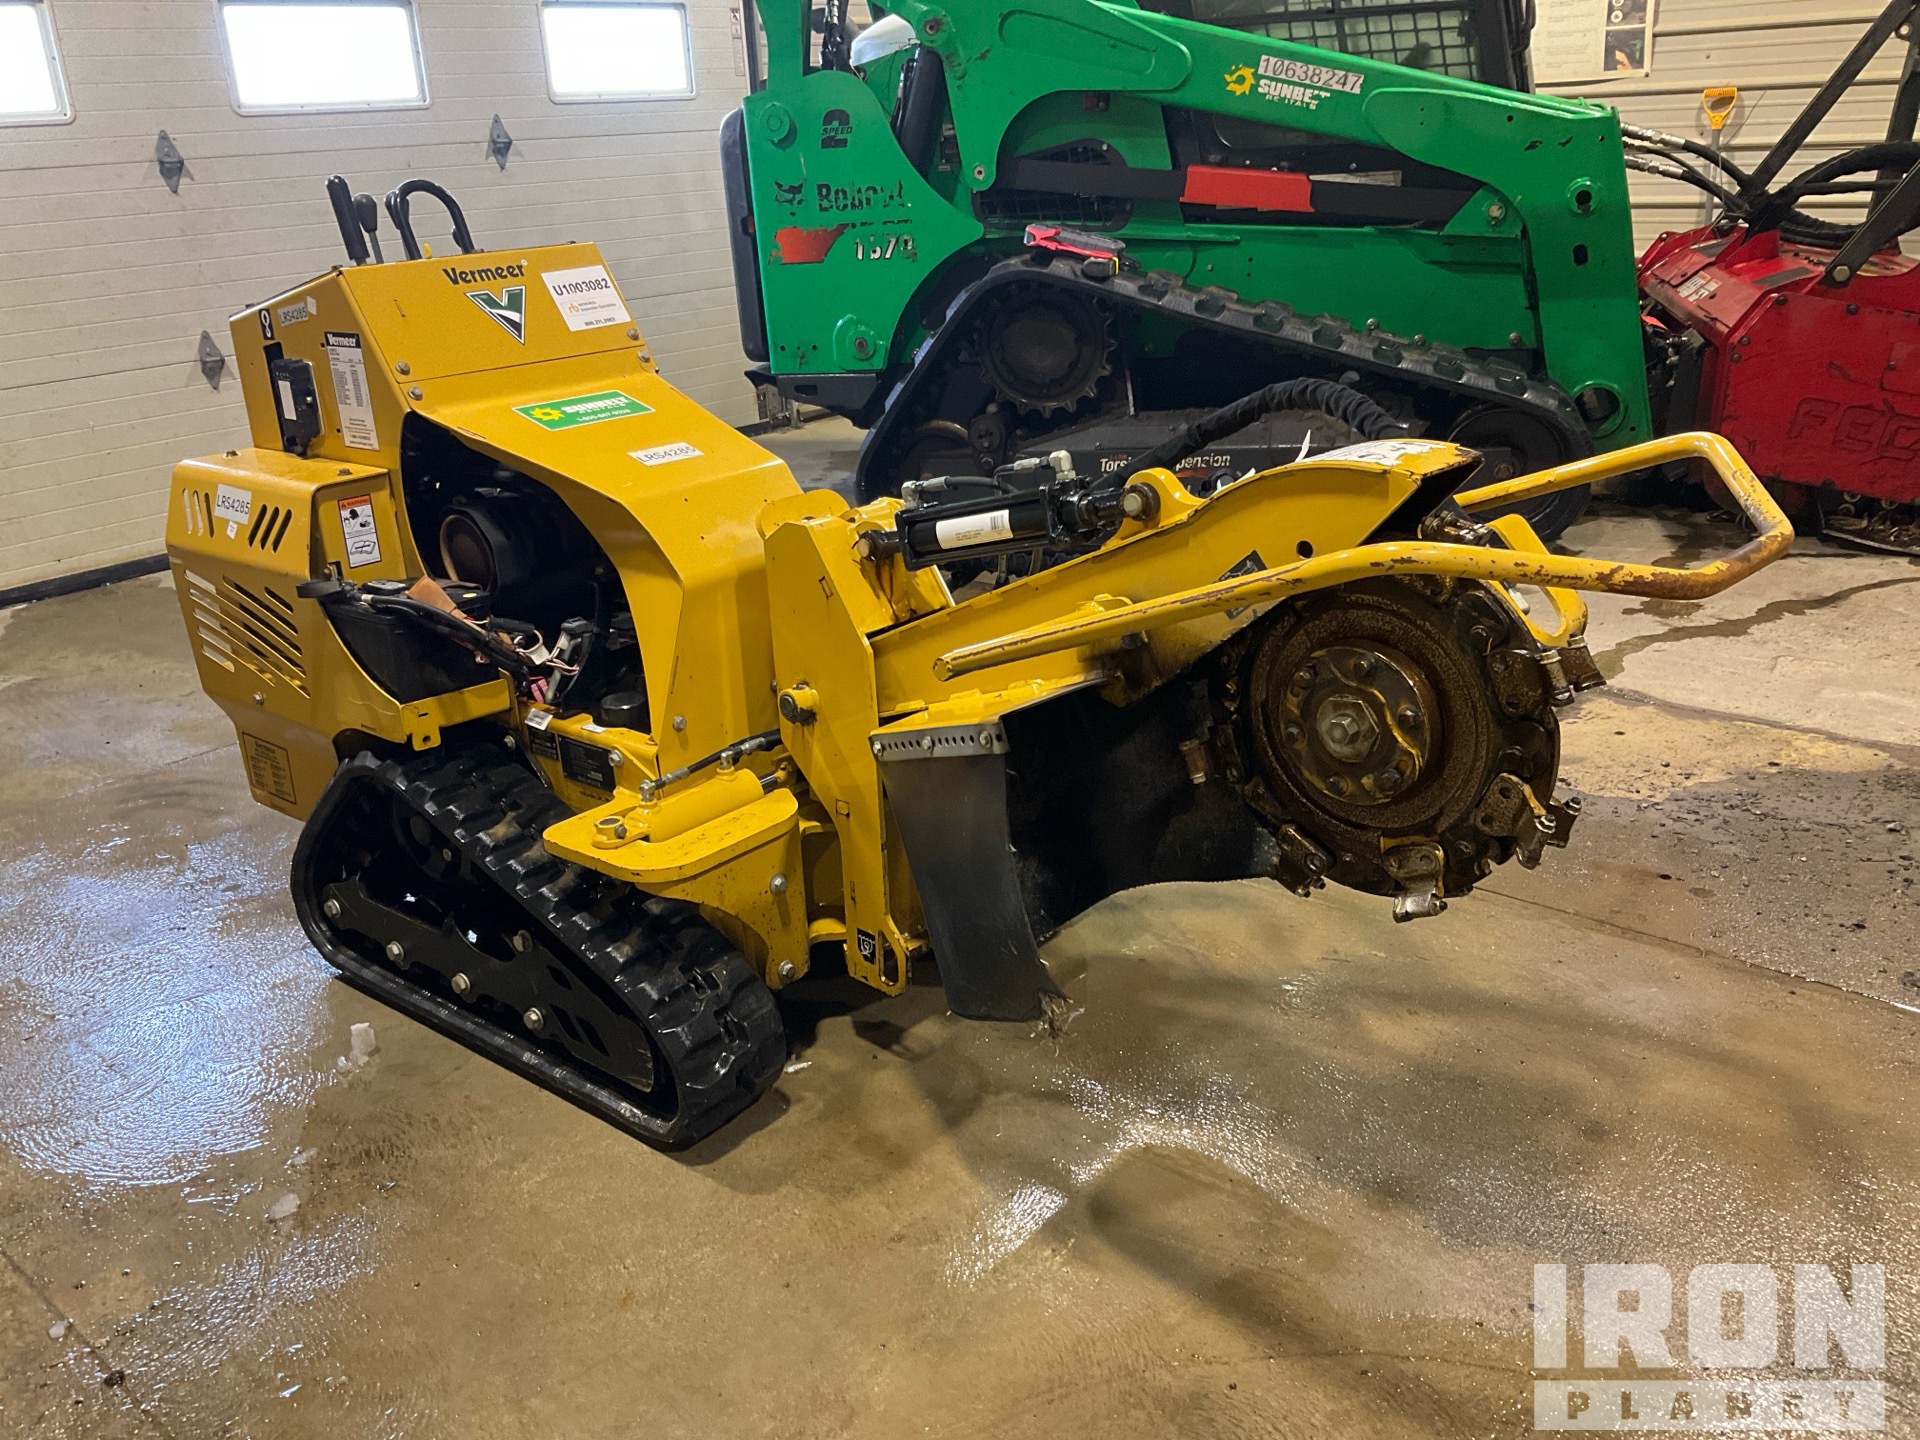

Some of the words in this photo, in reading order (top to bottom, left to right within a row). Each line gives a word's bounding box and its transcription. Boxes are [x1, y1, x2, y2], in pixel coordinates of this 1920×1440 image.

[1262, 56, 1364, 92] 10638247
[821, 126, 853, 137] SPEED
[442, 264, 525, 286] Vermeer
[552, 278, 611, 297] U1003082
[637, 445, 697, 464] LRS4285
[216, 493, 250, 515] LRS4285
